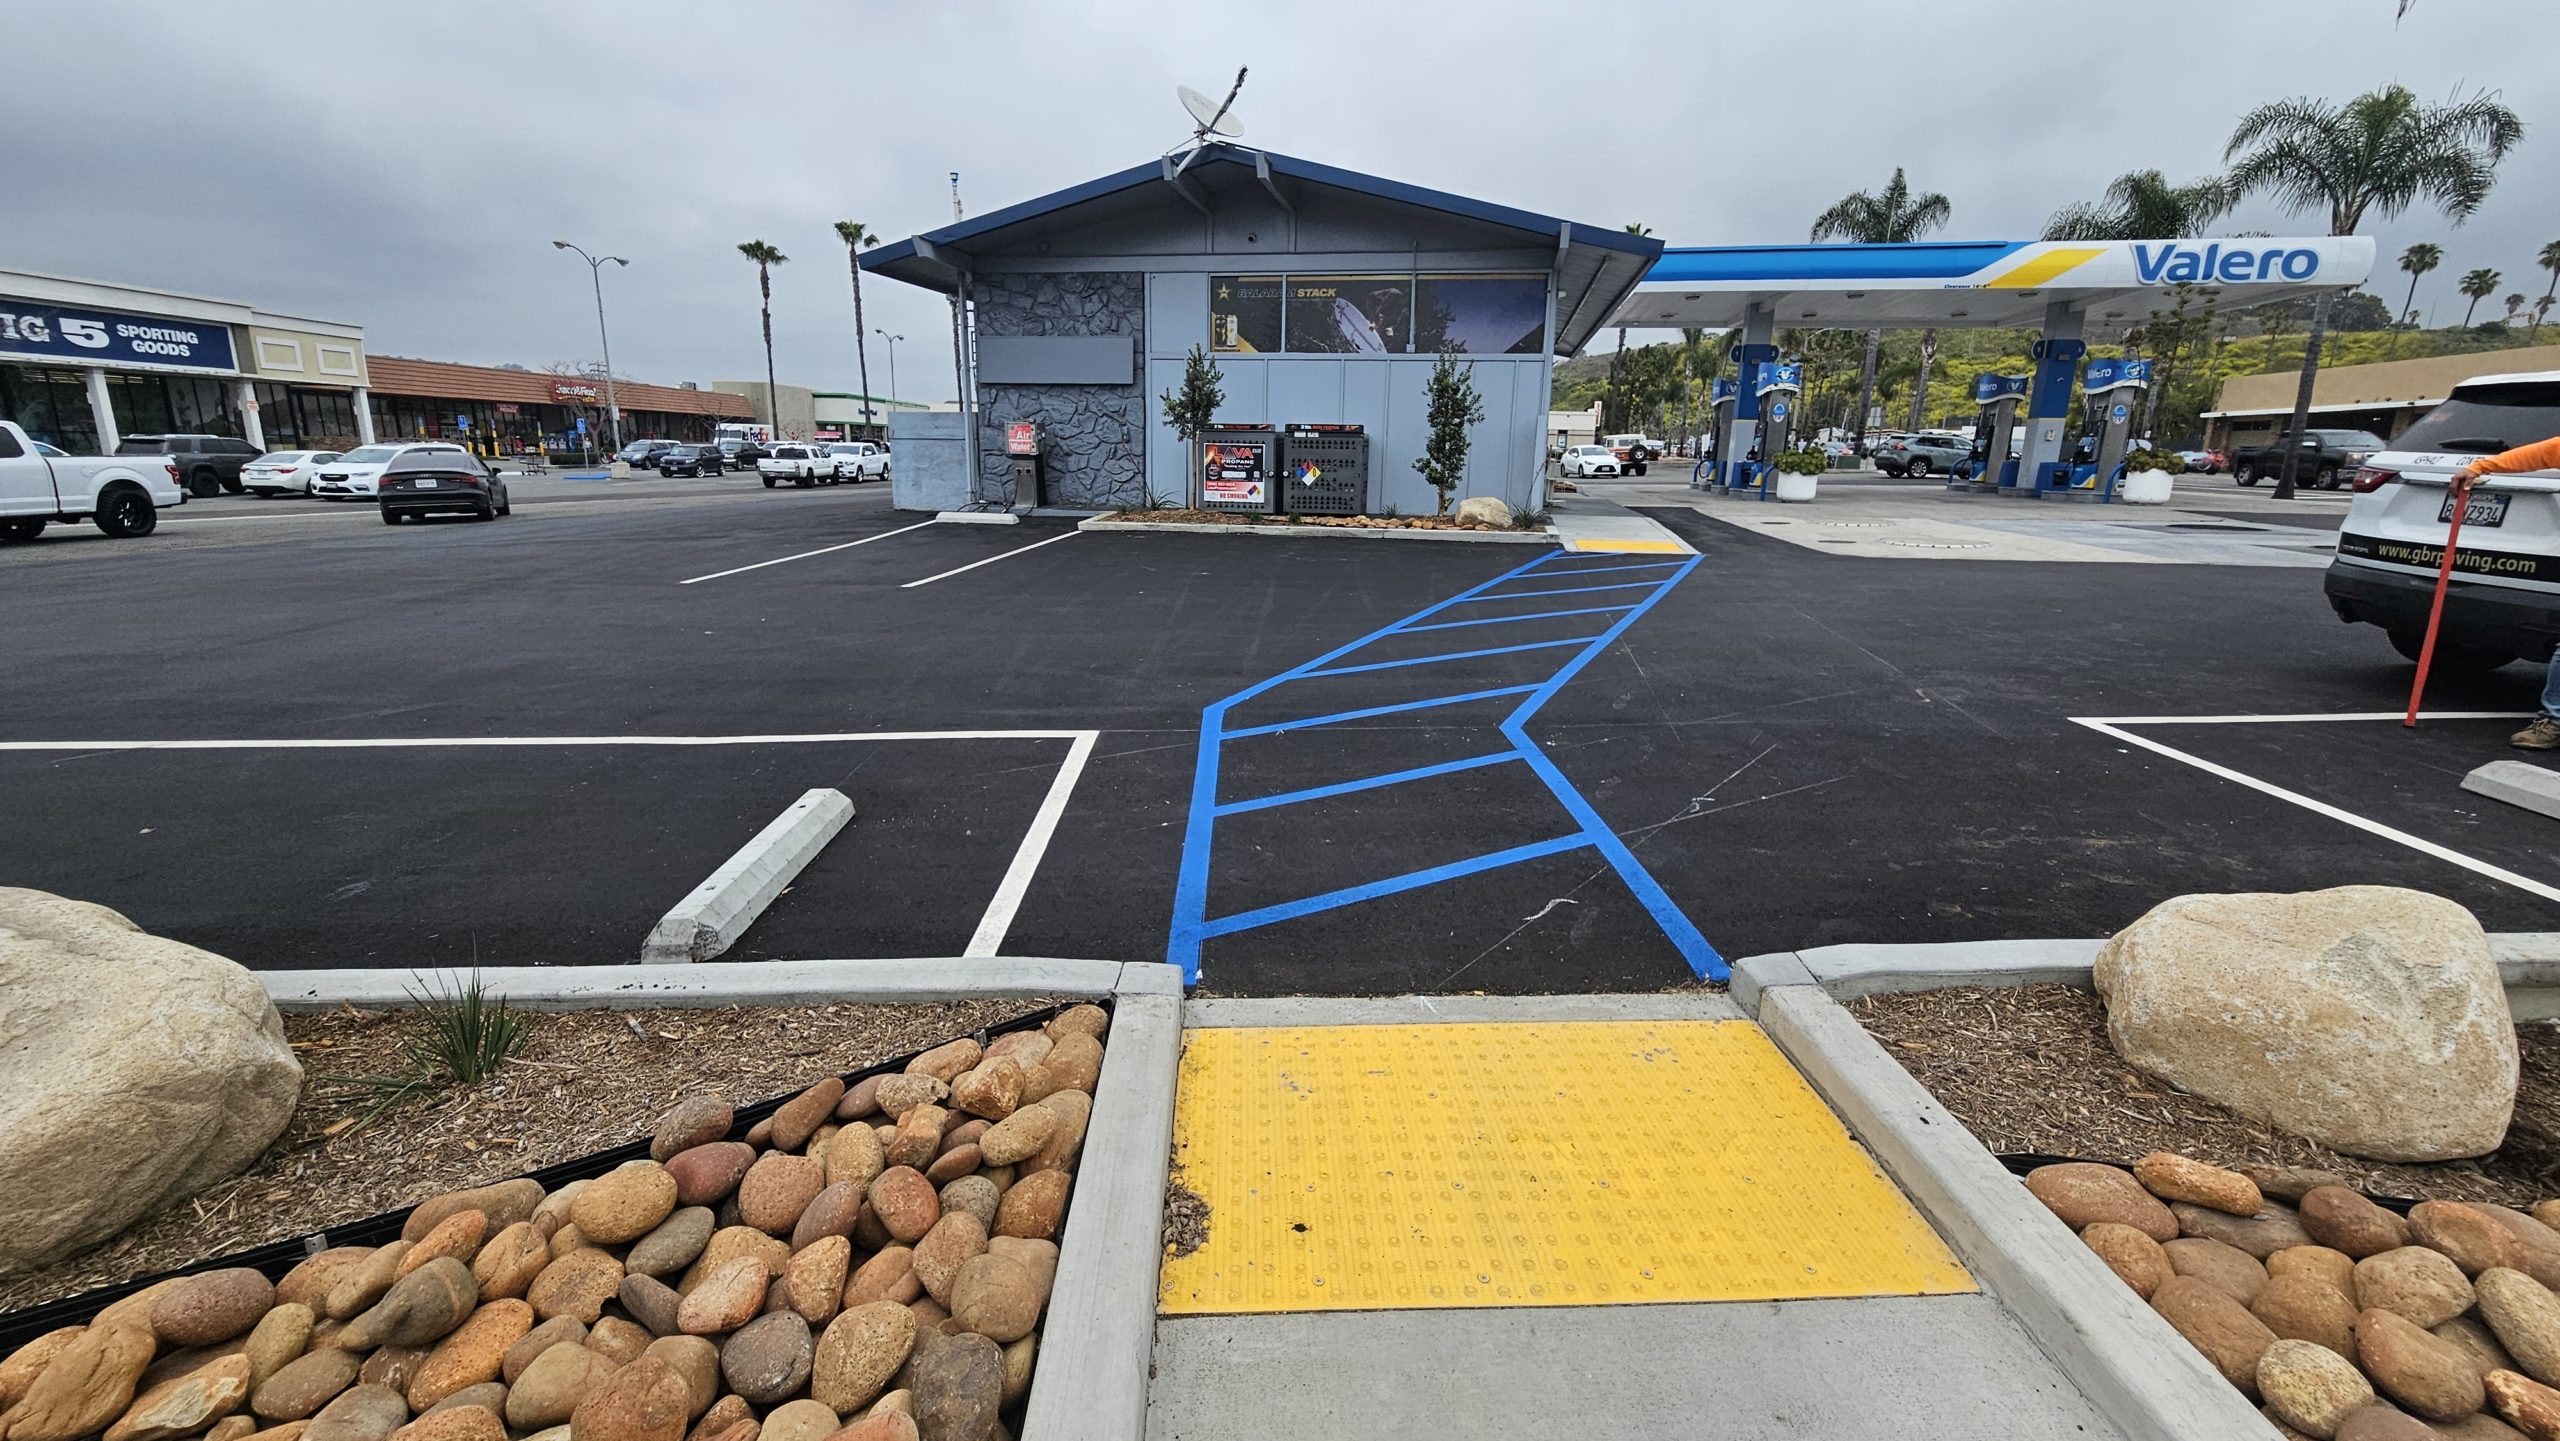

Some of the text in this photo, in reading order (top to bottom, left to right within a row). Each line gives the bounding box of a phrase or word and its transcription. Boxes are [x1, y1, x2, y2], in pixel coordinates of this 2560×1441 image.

[2134, 243, 2320, 282] Valero
[1297, 287, 1337, 298] STACK
[0, 313, 110, 349] IG 5
[116, 323, 199, 345] SPORTING
[131, 340, 191, 357] GOODS
[1016, 430, 1031, 440] Air
[1213, 446, 1254, 460] LAVA
[2444, 503, 2498, 522] 8Z934
[2378, 543, 2537, 573] www.gbrpving.com
